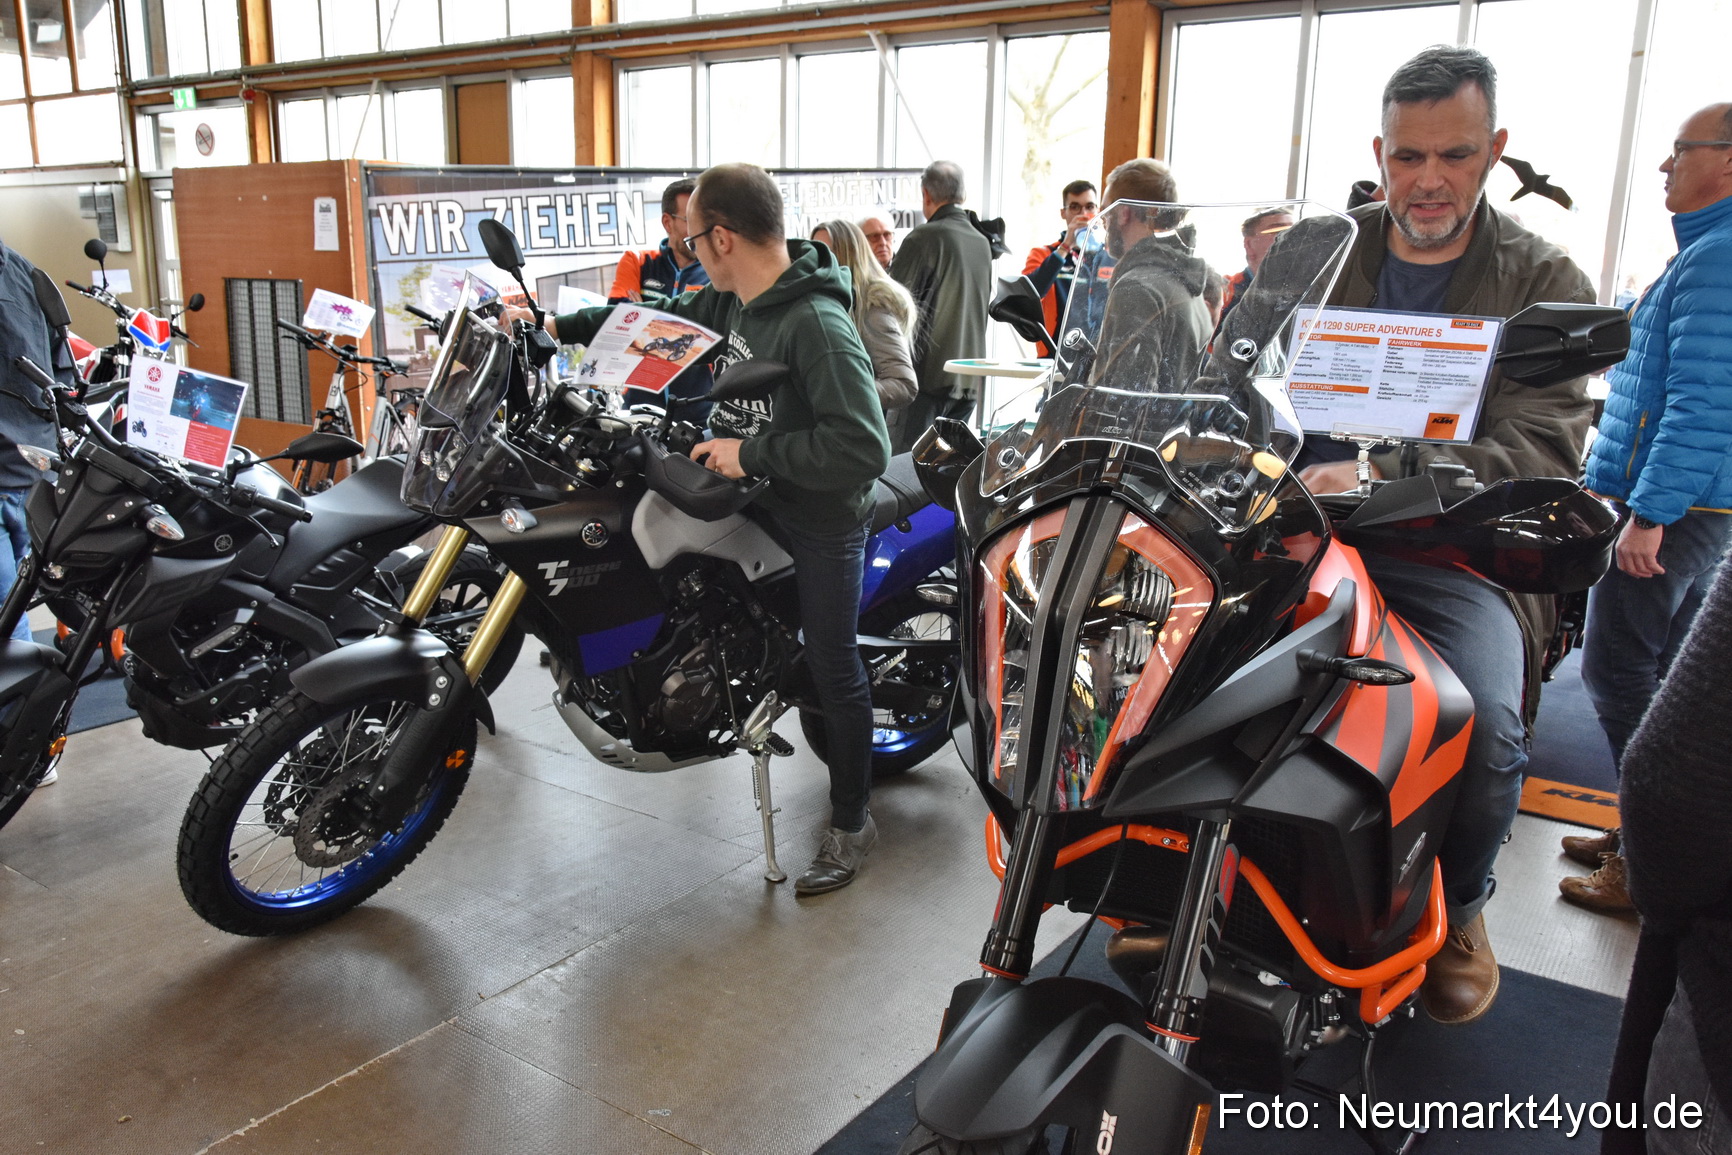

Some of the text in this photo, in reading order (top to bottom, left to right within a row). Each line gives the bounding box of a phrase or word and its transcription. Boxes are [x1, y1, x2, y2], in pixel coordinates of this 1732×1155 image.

[778, 176, 923, 208] EUERÖFFNUN
[377, 199, 470, 256] WIR
[501, 284, 524, 292] YAMAH
[1323, 320, 1343, 330] 1290
[1344, 322, 1375, 333] SUPER
[1377, 324, 1434, 337] ADVENTURE
[1435, 328, 1443, 338] S
[1387, 339, 1422, 347] FAHRWERK
[144, 384, 160, 393] YAMAHA
[1290, 383, 1334, 391] AUSSTATTUNG
[548, 573, 601, 597] 700
